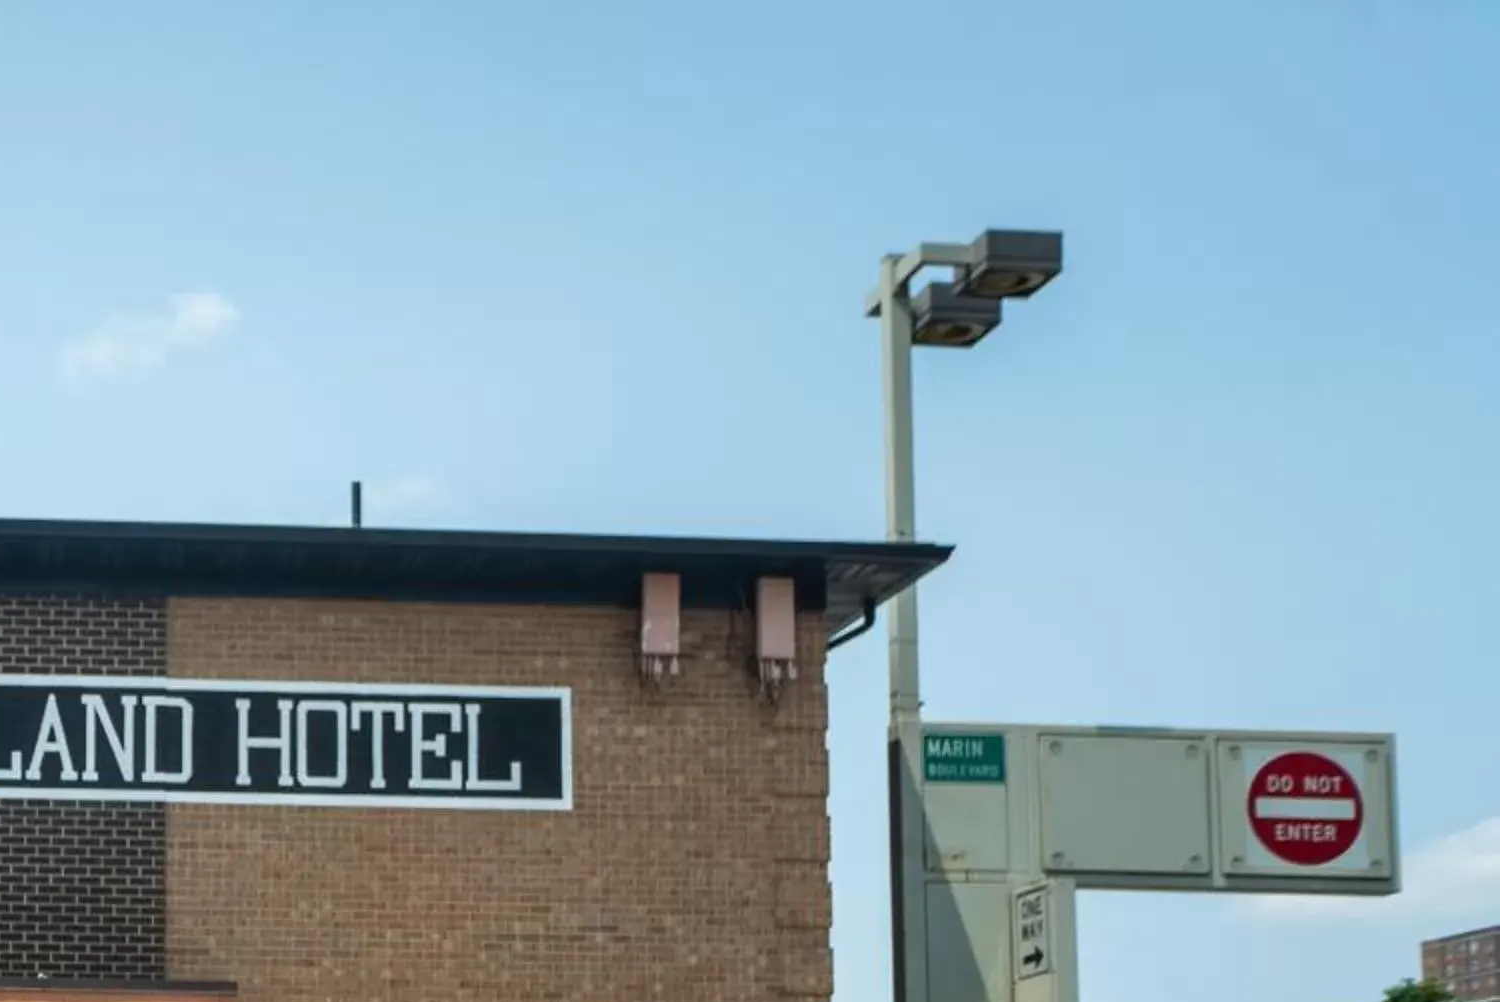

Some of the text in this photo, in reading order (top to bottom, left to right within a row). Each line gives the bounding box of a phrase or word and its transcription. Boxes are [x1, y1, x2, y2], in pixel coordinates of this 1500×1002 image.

[235, 698, 521, 790] HOTEL
[928, 738, 983, 757] MARIN
[1266, 775, 1342, 793] DO NOT
[1275, 822, 1337, 842] ENTER
[1021, 896, 1043, 919] ONE
[1021, 919, 1044, 941] WAY
